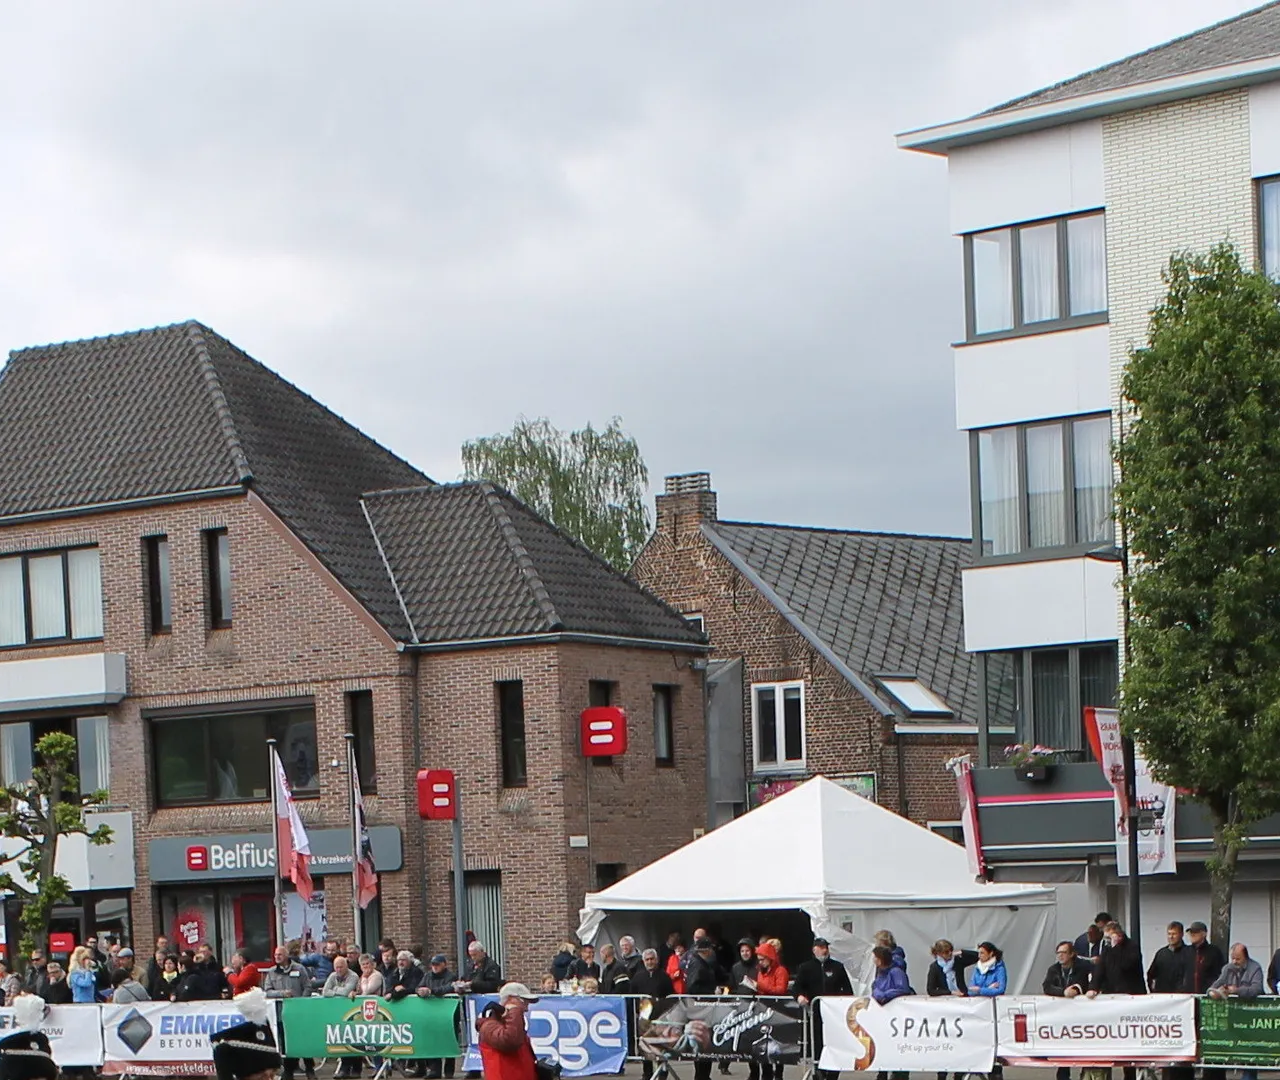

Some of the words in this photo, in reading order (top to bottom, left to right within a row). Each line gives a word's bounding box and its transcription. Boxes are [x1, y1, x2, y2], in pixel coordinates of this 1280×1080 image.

[1120, 1014, 1182, 1023] FRANKENGLAS
[1250, 1018, 1273, 1029] JAN
[890, 1017, 964, 1038] SPAAS
[1038, 1025, 1183, 1039] GLASSOLUTIONS
[326, 1024, 414, 1044] MARTENS
[160, 1039, 209, 1048] BETON
